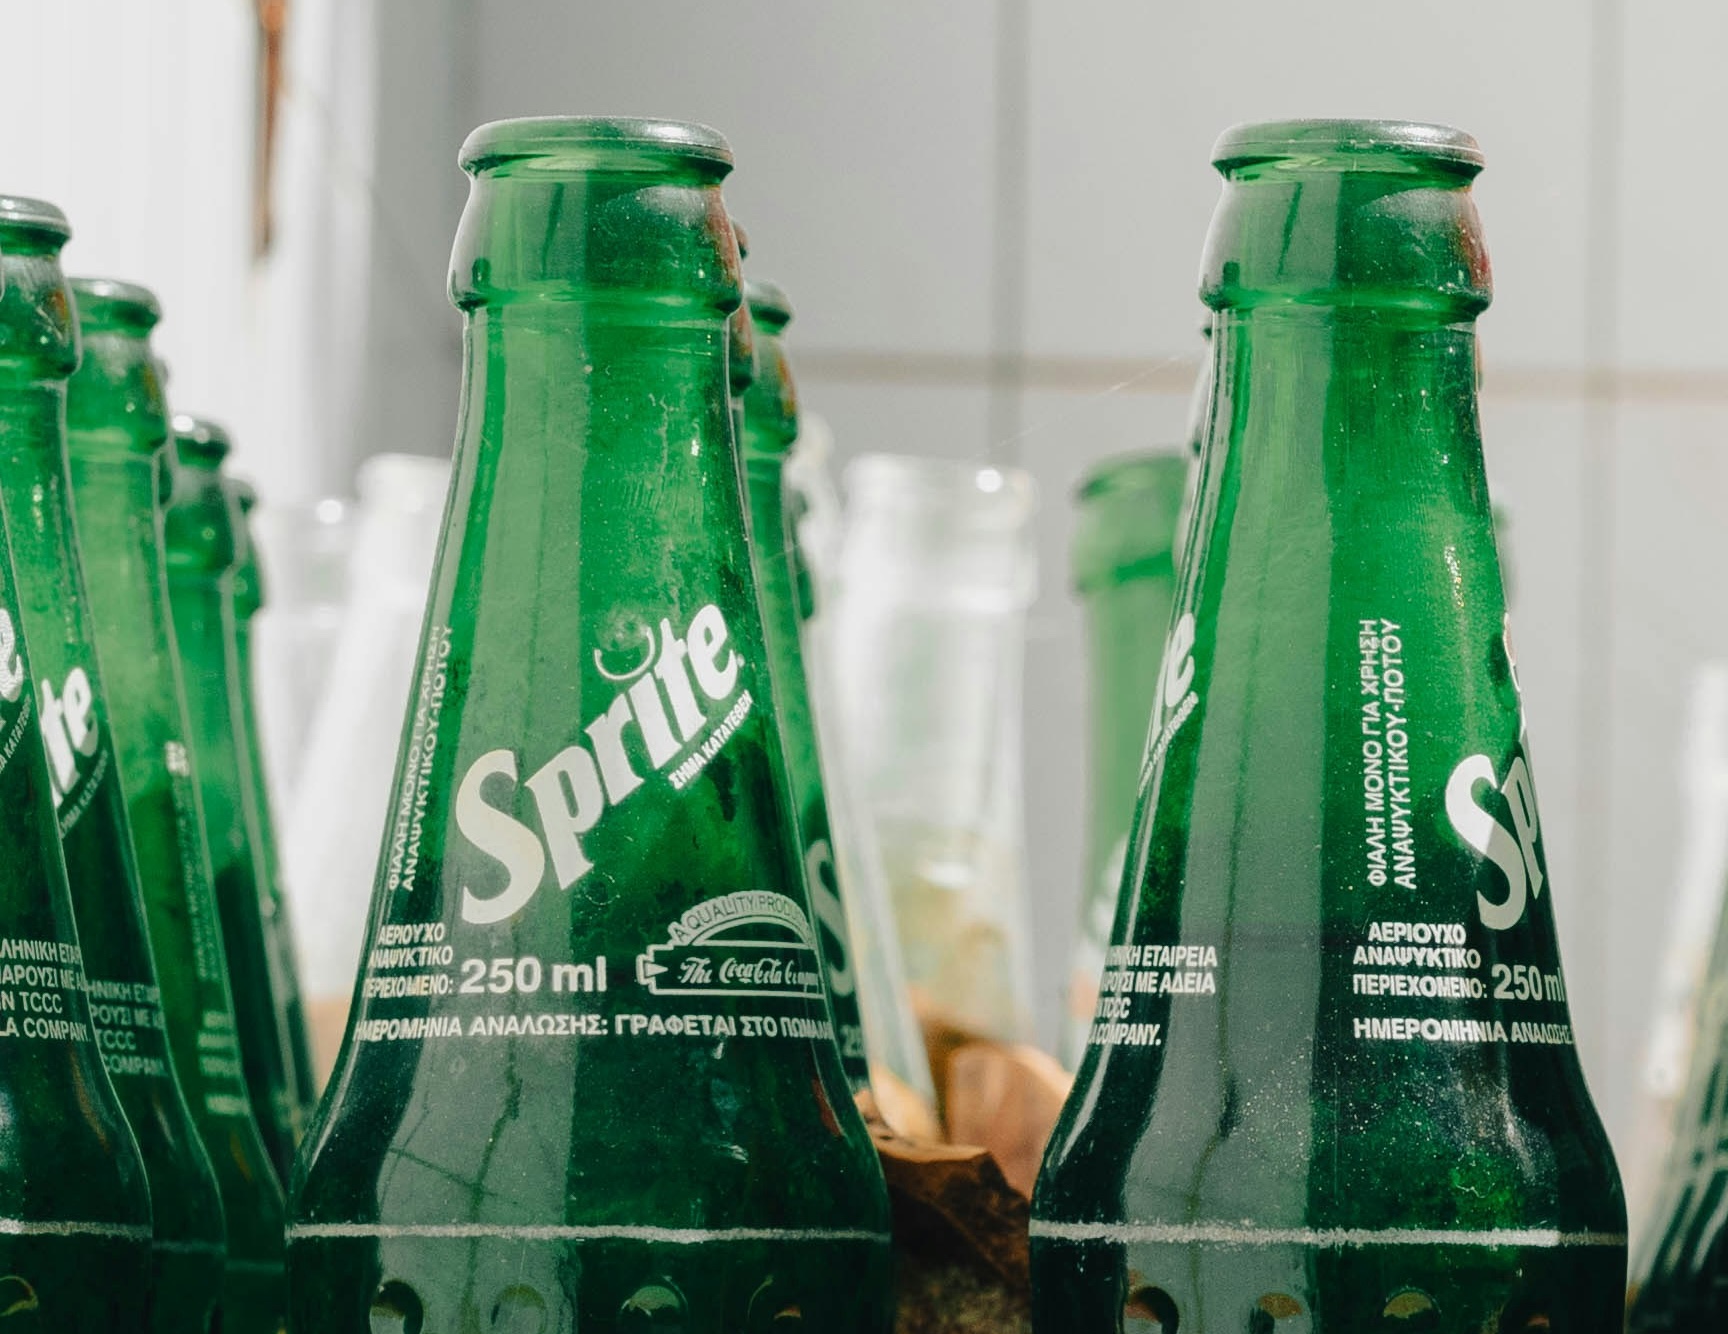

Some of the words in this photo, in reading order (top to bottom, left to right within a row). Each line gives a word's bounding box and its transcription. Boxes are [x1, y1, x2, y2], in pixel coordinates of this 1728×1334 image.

[1359, 620, 1380, 695] ΧΡΗΣΗ
[1362, 701, 1381, 735] ΓΙΑ
[456, 604, 739, 924] Sprite
[1362, 740, 1384, 811] ΜΟΝΟ
[1366, 817, 1387, 887] ΦΙΑΛΗ
[687, 896, 753, 929] QUALITY
[1368, 922, 1467, 945] ΑΕΡΙΟΥΧΟ
[1142, 944, 1218, 967] ΕΤΑΙΡΕΙΑ
[1353, 945, 1481, 969] ΑΝΑΨΥΚΤΙΚΟ
[0, 964, 58, 987] ΑΡΟΥΣΙ
[460, 956, 542, 994] 250
[552, 956, 607, 992] ml
[1135, 971, 1159, 992] ΜΕ
[1159, 971, 1216, 994] ΑΔΕΙΑ
[1353, 973, 1488, 999] ΠΕΡΙΕΧΟΜΕΝΟ:
[1491, 963, 1543, 1001] 250
[19, 991, 62, 1014] TCCC
[468, 1014, 608, 1036] ΑΝΑΛΩΣΗΣ:
[614, 1014, 737, 1037] ΓΡΑΦΕΤΑΙ
[741, 1016, 778, 1037] ΣΤΟ
[1353, 1017, 1508, 1042] ΗΜΕΡΟΜΗΝΙΑ
